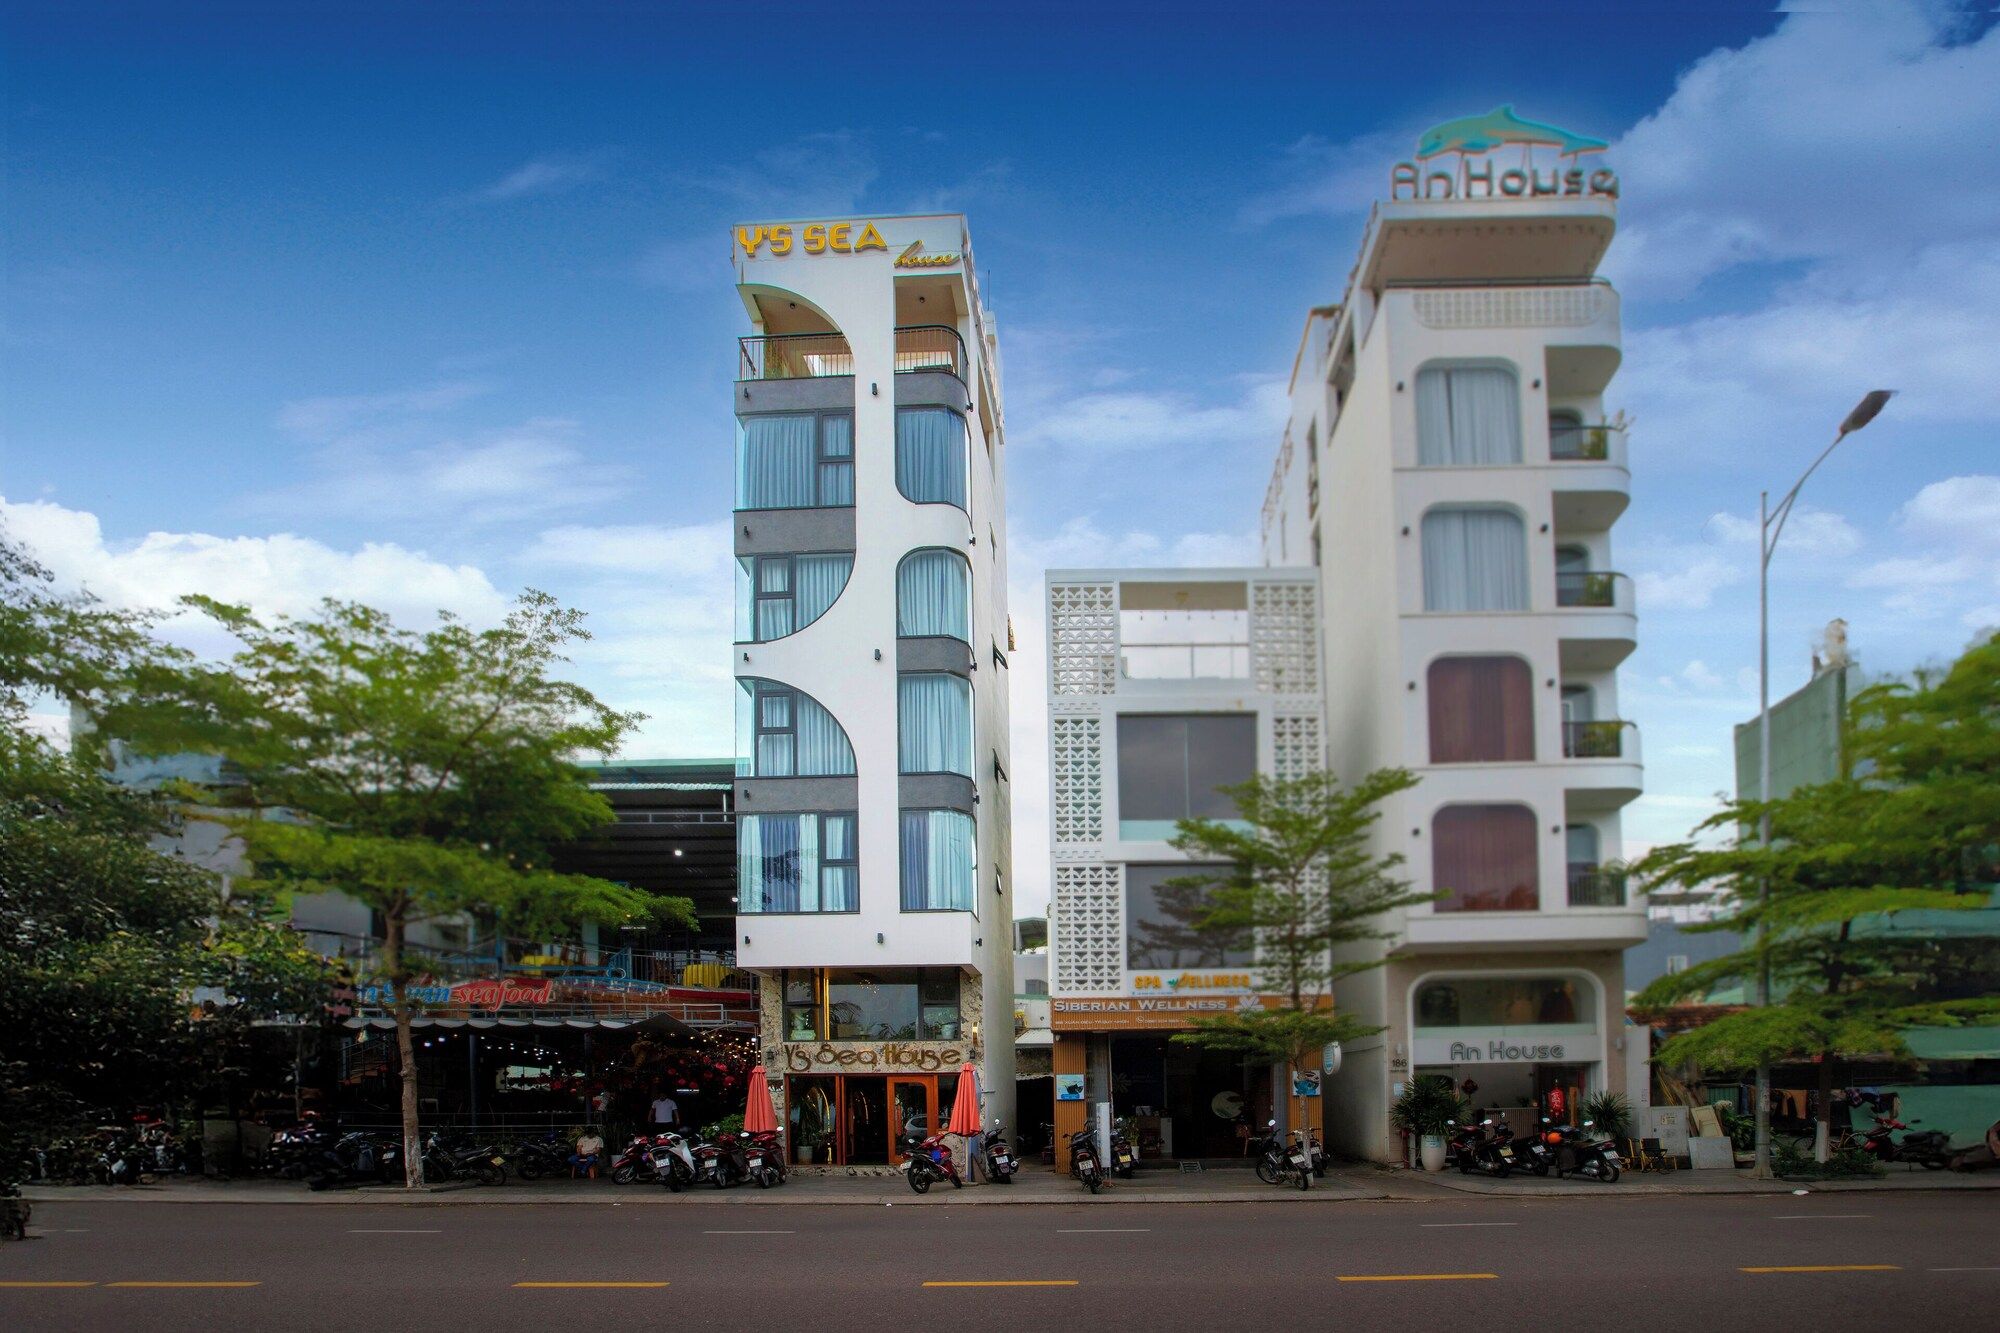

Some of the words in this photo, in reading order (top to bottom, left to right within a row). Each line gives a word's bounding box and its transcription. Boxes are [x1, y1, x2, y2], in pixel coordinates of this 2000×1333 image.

[1392, 162, 1453, 199] An
[1464, 159, 1618, 198] House
[738, 225, 792, 257] Y'S
[803, 221, 888, 253] SEA
[1134, 974, 1161, 989] SPA
[457, 979, 554, 1012] seafood
[1054, 1000, 1130, 1012] SIBERIAN
[1137, 999, 1227, 1011] WELLNESS
[1450, 1041, 1481, 1060] An
[1489, 1040, 1564, 1059] House
[1391, 1058, 1408, 1068] 186
